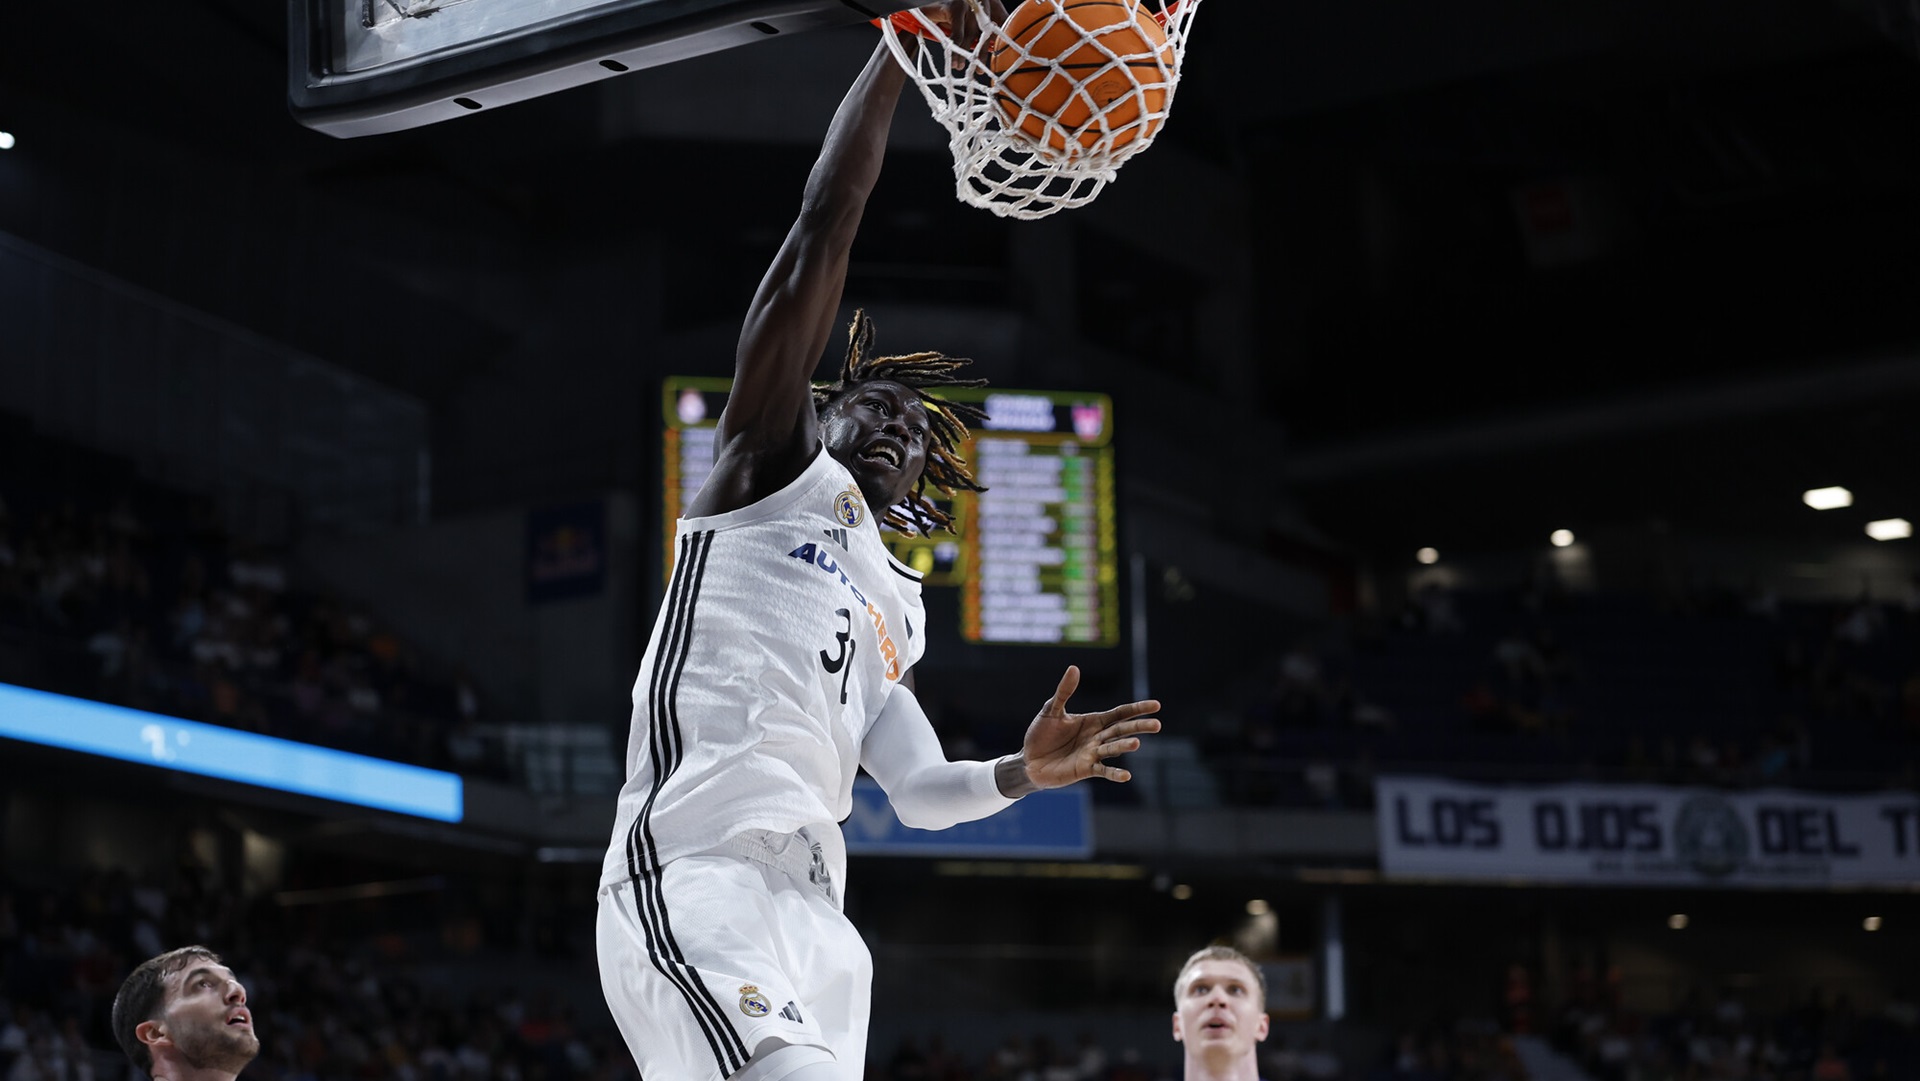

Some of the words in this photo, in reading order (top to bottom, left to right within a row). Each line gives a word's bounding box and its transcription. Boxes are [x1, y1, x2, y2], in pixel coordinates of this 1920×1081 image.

[788, 542, 899, 681] AUTOHERO
[1395, 796, 1500, 849] LOS
[1534, 802, 1662, 853] OJOS
[1756, 807, 1858, 857] DEL
[1881, 807, 1920, 857] T
